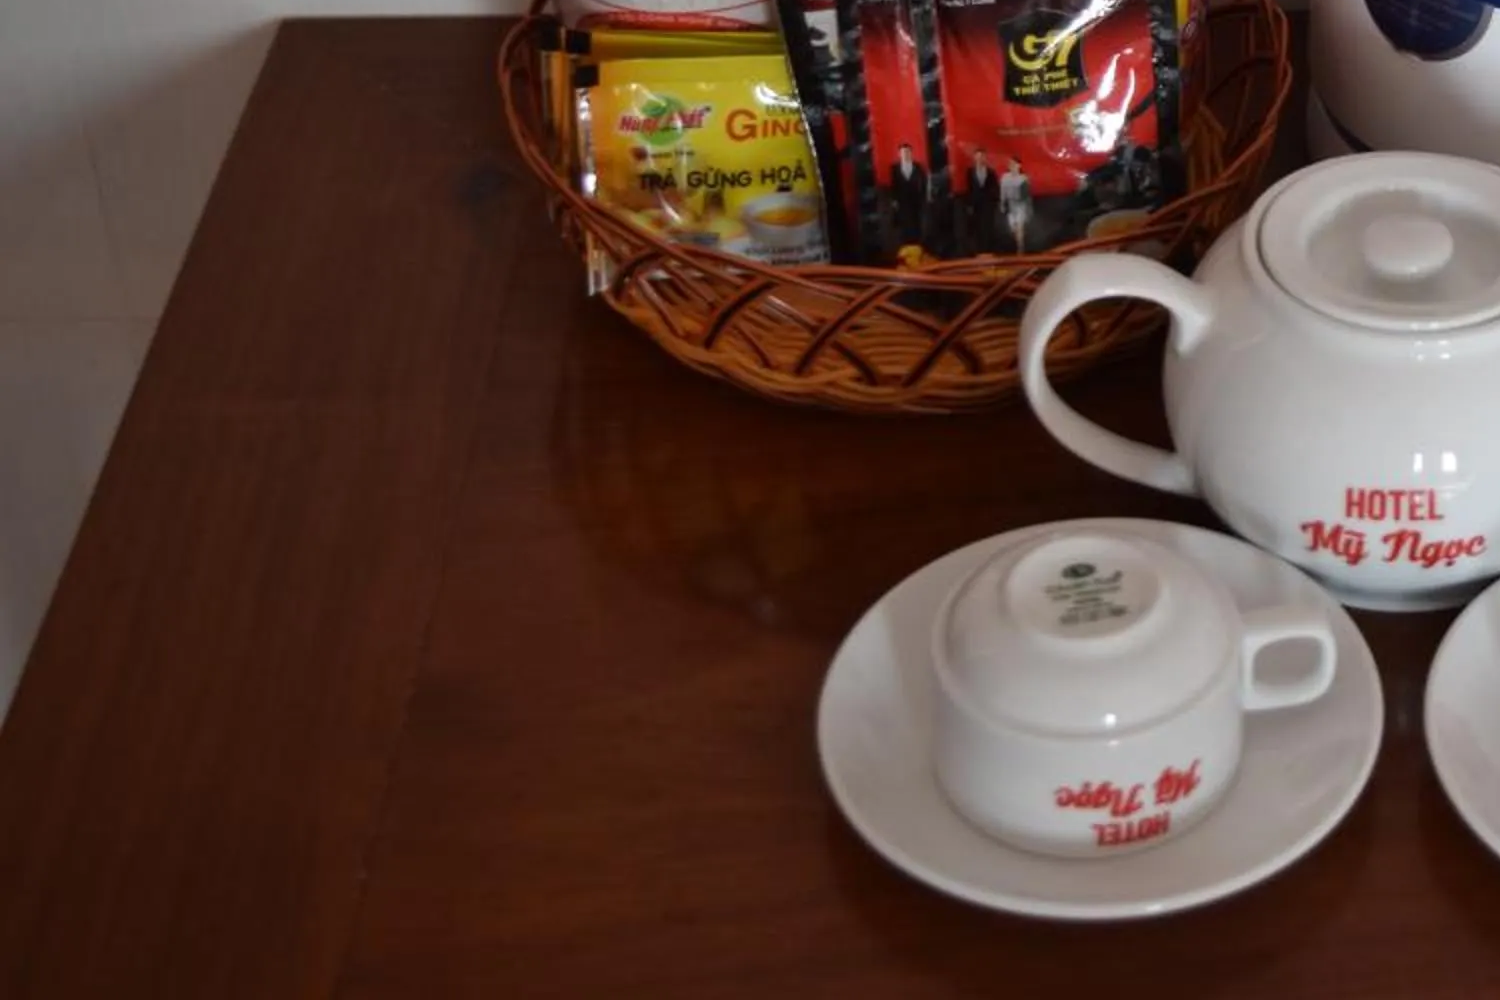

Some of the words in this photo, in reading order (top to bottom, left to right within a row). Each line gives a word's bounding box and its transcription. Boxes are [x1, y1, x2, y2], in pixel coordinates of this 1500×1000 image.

[1008, 29, 1078, 71] G7
[1345, 488, 1444, 520] HOTEL
[1301, 520, 1368, 566] Mỹ
[1382, 529, 1487, 568] Ngọc
[1053, 781, 1143, 817] Ngọc
[1092, 811, 1171, 846] HOTEL
